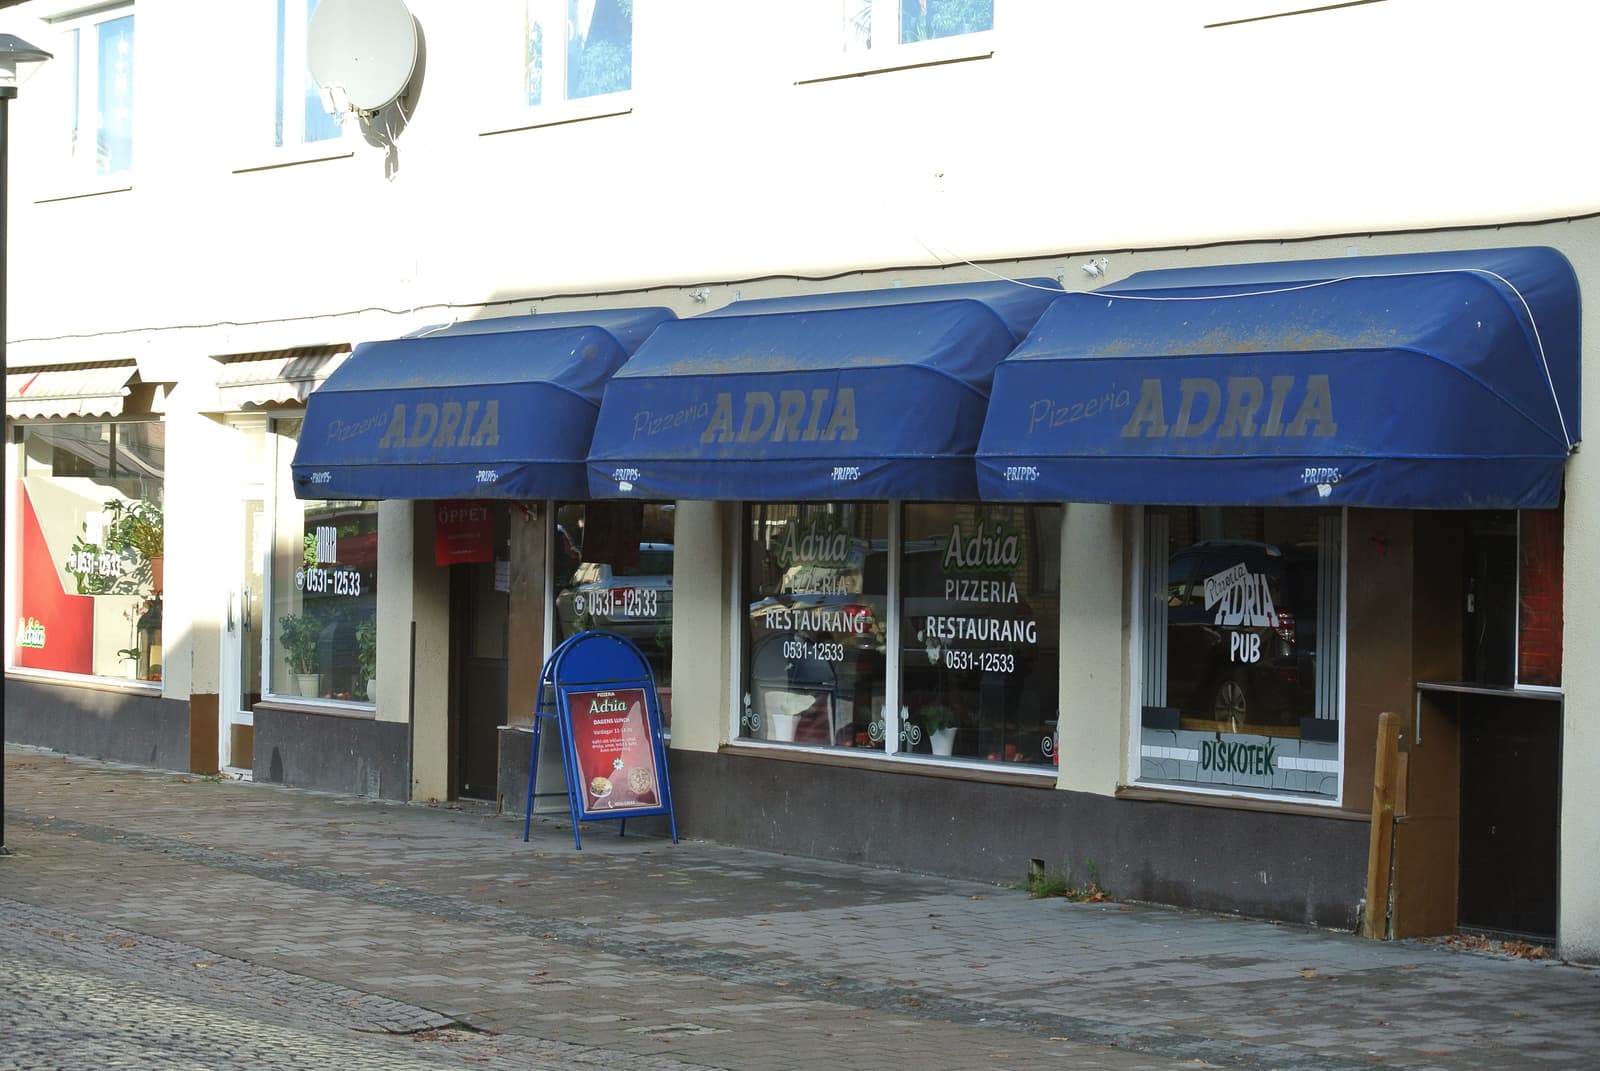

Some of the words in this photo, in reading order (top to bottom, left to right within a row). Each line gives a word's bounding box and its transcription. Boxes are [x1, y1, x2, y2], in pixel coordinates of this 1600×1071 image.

[632, 402, 709, 440] Pizzeria
[700, 388, 859, 443] ADRIA
[1028, 383, 1130, 433] Pizzeria
[1120, 375, 1337, 438] ADRIA
[379, 400, 500, 448] ADRIA
[780, 520, 849, 562] Adria
[943, 522, 1020, 568] Adria
[306, 568, 360, 596] 0531-12533
[780, 574, 848, 596] PIZZERIA
[945, 579, 1019, 604] PIZZERIA
[588, 589, 658, 617] 0531-12533
[1214, 573, 1280, 628] ADRIA
[766, 610, 864, 634] RESTAURANG
[926, 615, 1037, 644] RESTAURANG
[783, 640, 844, 662] 0531-12533
[945, 650, 1015, 674] 0531-12533
[1230, 631, 1261, 664] PUB
[589, 699, 628, 715] Adria
[1202, 739, 1275, 776] DISKOTEK
